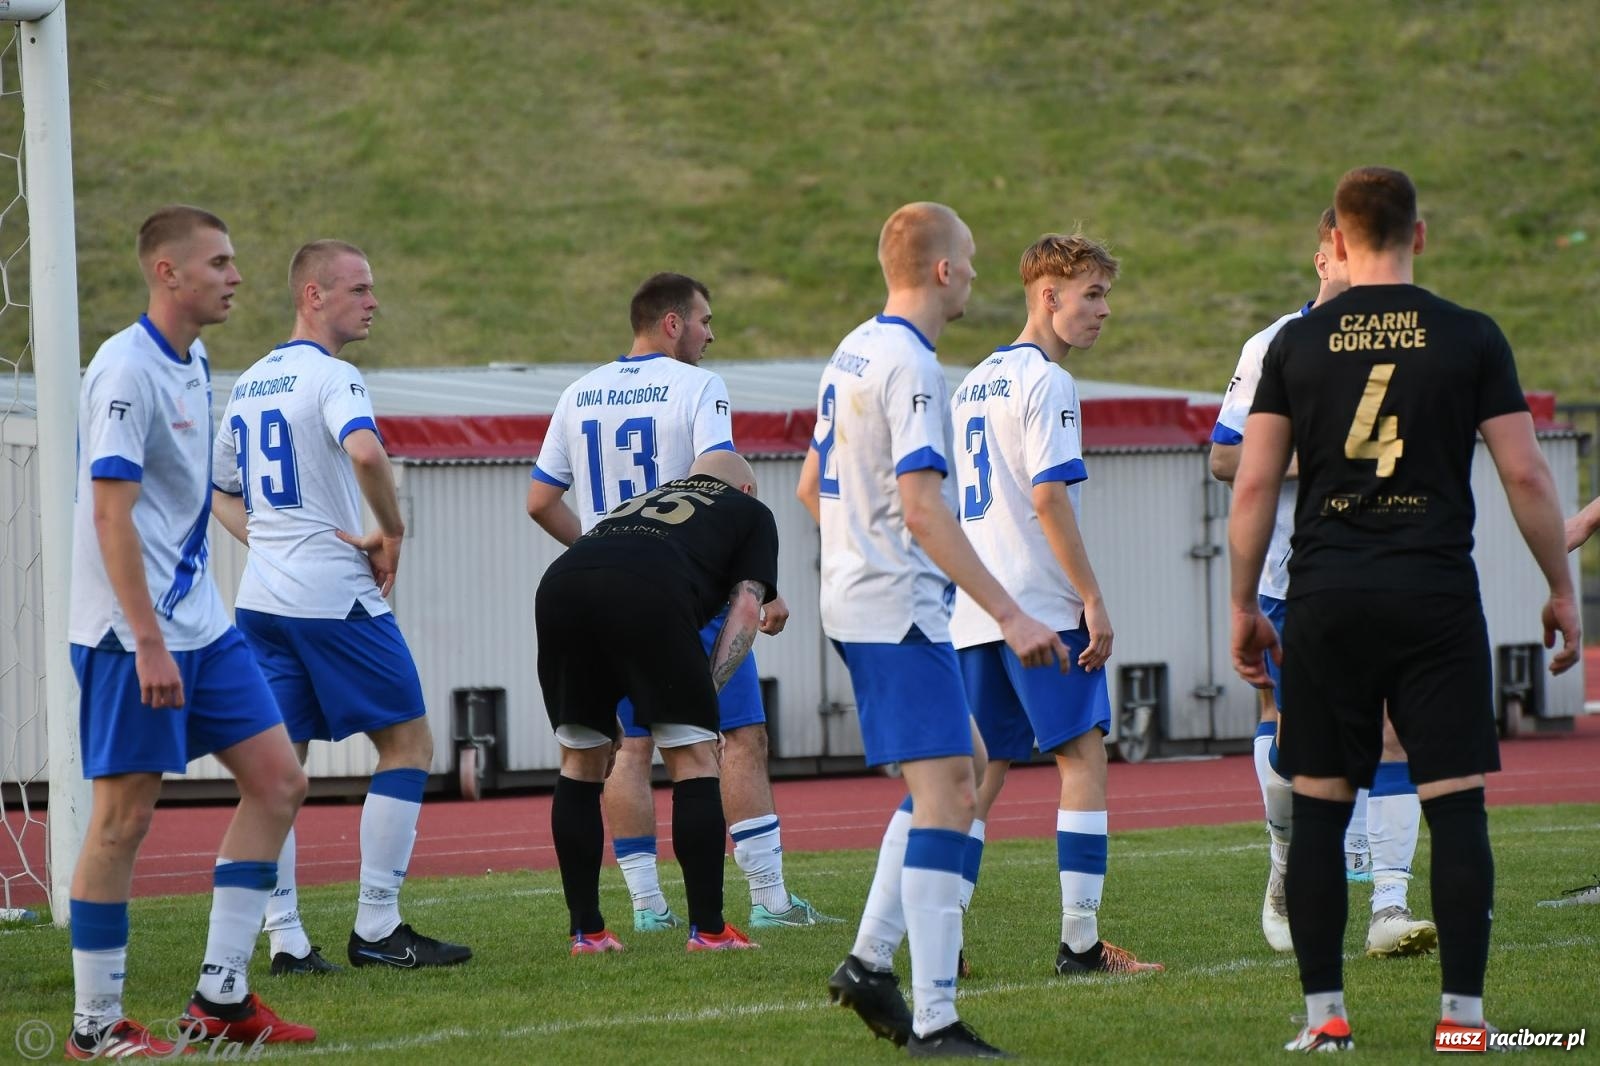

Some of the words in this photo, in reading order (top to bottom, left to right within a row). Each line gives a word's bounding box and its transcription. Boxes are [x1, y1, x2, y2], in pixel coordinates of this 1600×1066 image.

[1328, 328, 1426, 352] GORZYCE
[1340, 311, 1418, 331] CZARNI
[576, 388, 603, 408] UNIA
[606, 383, 669, 406] RACIBÓRZ
[818, 383, 841, 500] 2
[1345, 363, 1404, 478] 4
[581, 416, 661, 516] 13
[964, 415, 993, 522] 3
